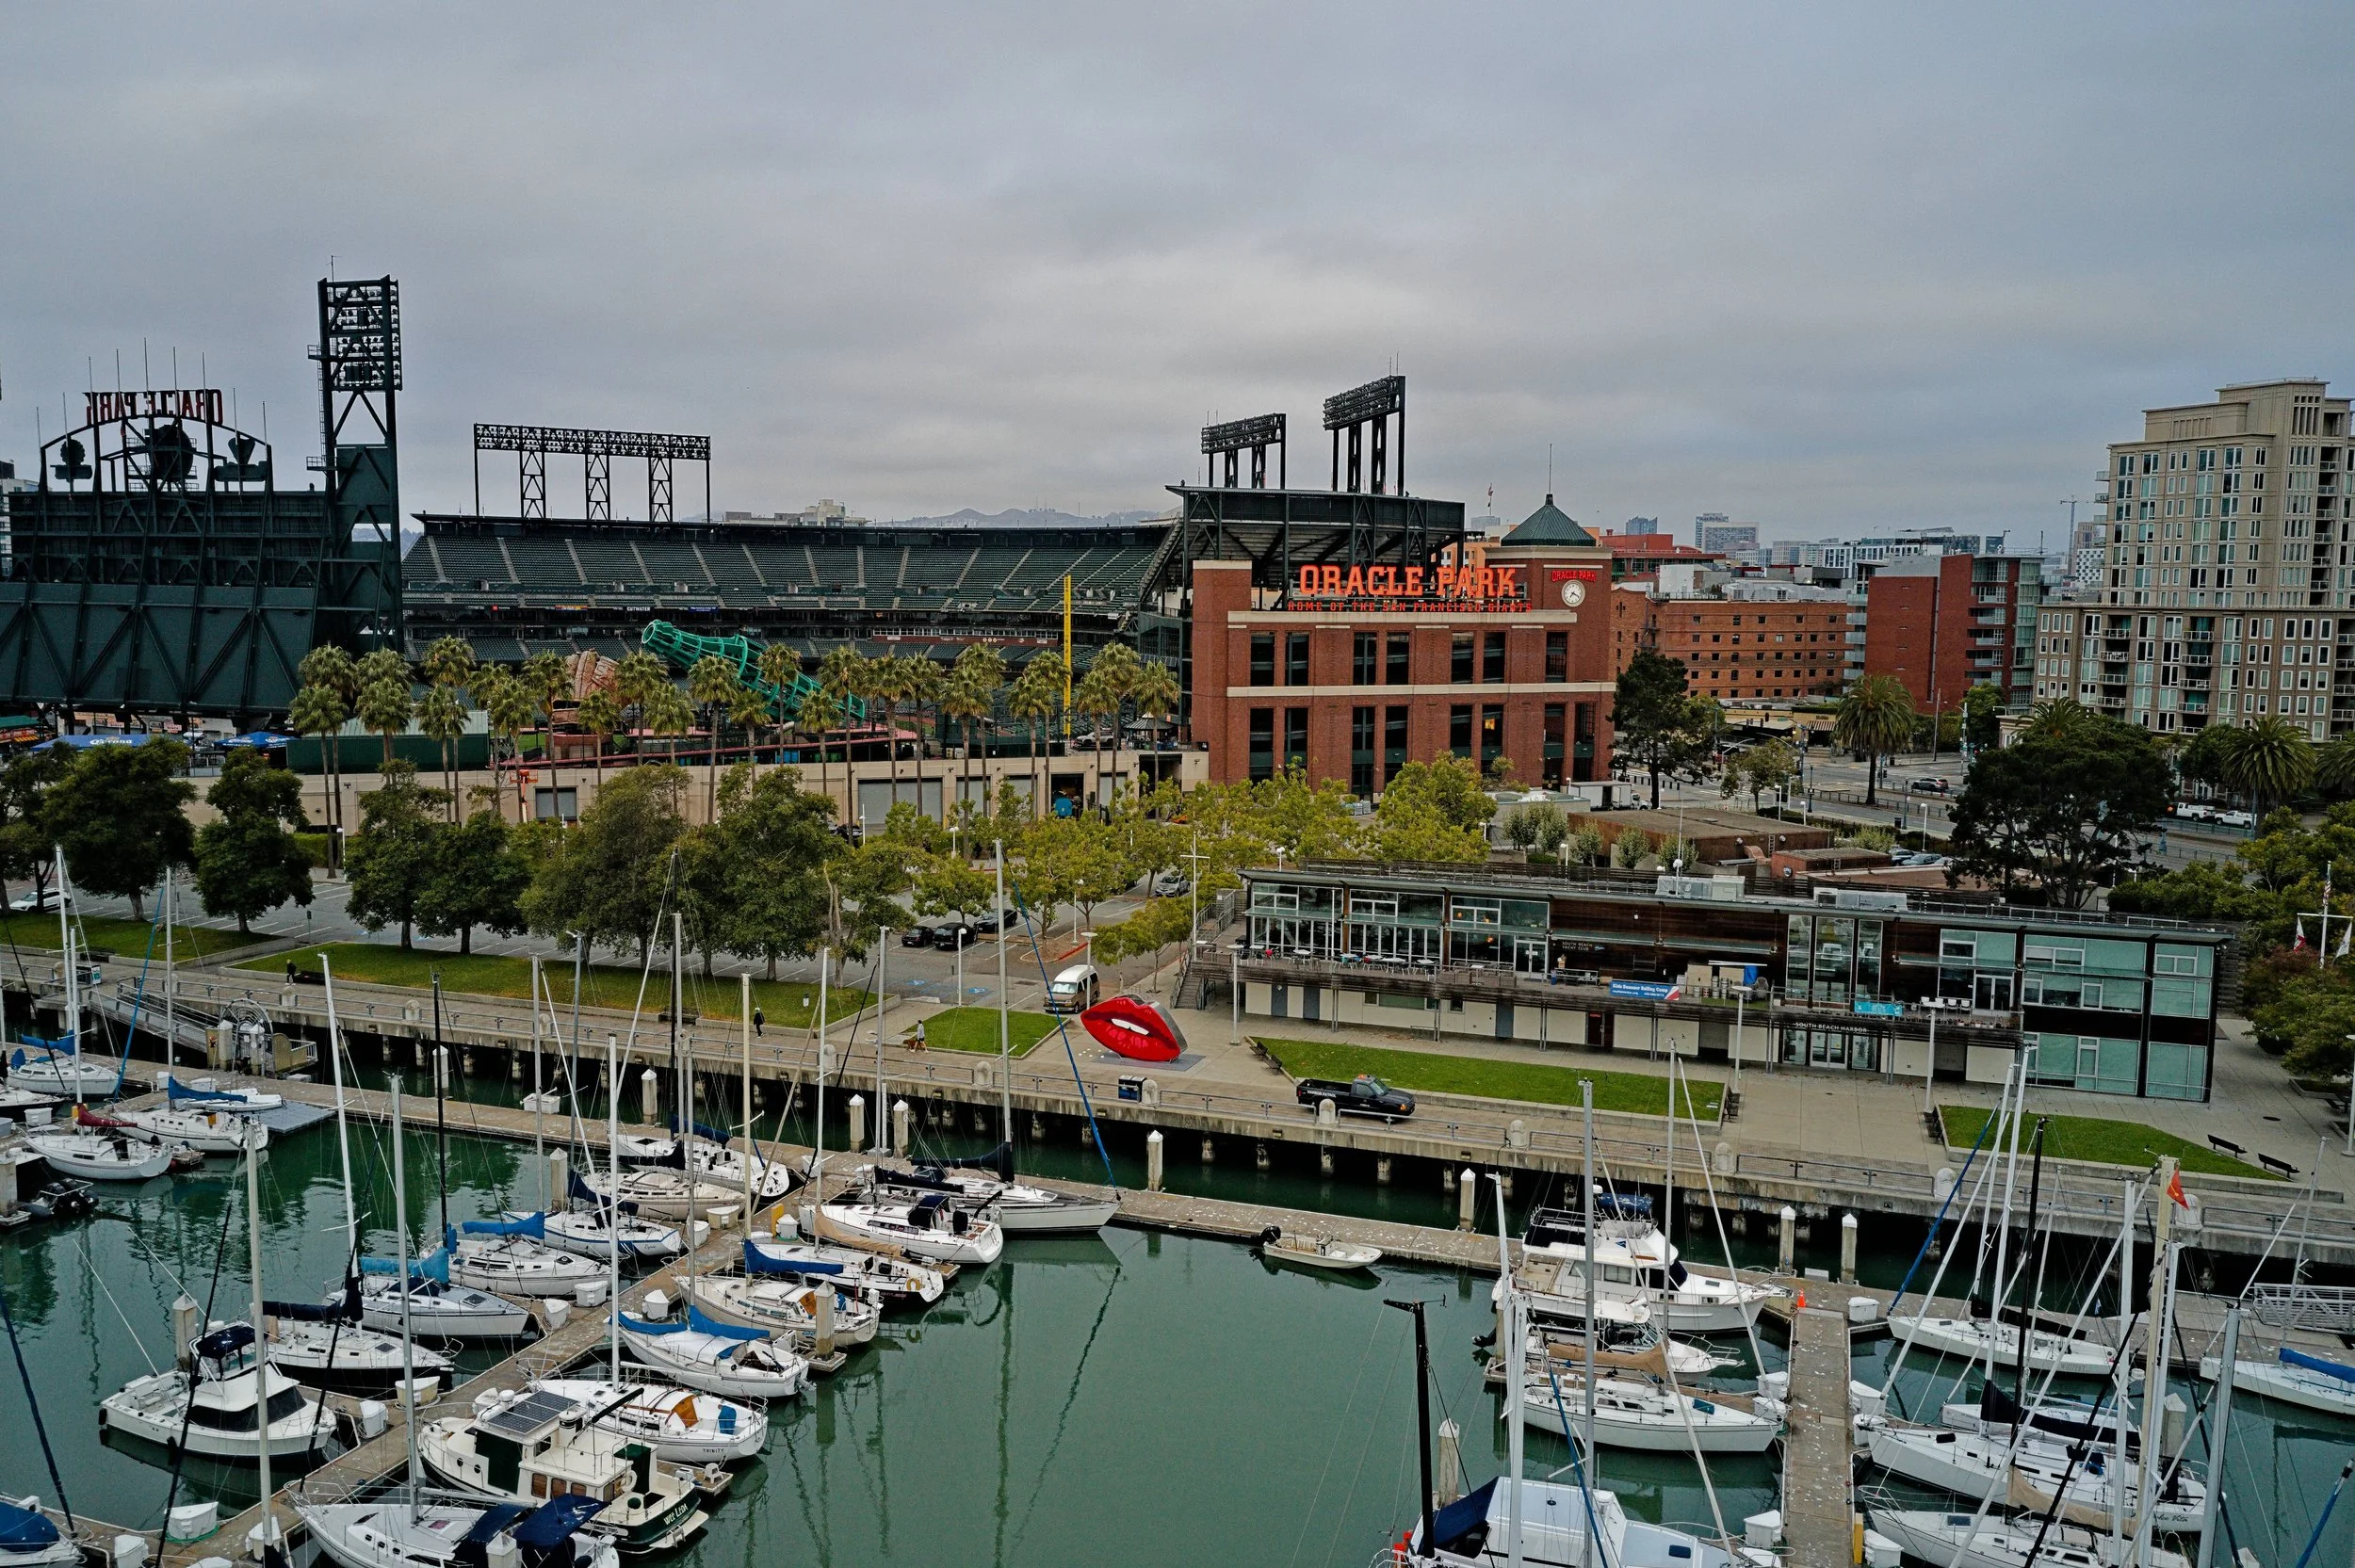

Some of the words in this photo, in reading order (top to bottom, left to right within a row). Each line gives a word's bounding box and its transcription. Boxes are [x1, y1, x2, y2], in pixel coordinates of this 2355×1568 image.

[1300, 564, 1423, 596] ORACLE
[1436, 566, 1516, 597] PARK
[1551, 570, 1577, 582] ORACLE
[1578, 570, 1597, 583] PARK
[1288, 601, 1323, 611] HOME
[1330, 602, 1345, 611] OF
[1352, 602, 1375, 611] THE
[1382, 602, 1406, 611] SAN
[1413, 602, 1482, 612] FRANCISCO
[1488, 603, 1533, 612] GIANTS
